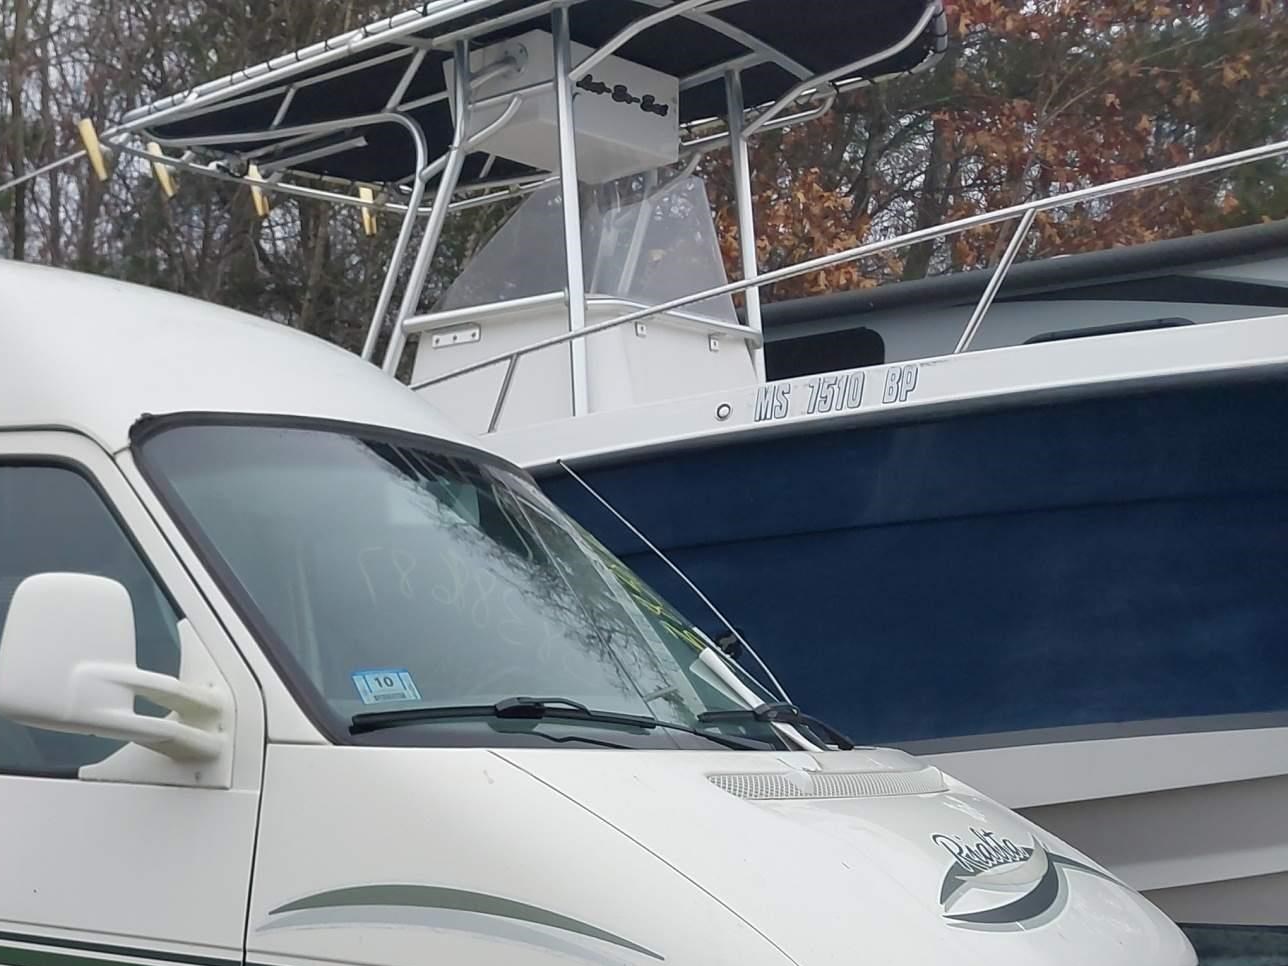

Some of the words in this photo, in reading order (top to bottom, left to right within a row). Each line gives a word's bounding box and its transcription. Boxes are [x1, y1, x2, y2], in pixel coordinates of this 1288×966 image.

[754, 383, 791, 422] MS
[882, 366, 919, 403] BP
[374, 676, 395, 689] 10
[930, 825, 1030, 872] Rialta
